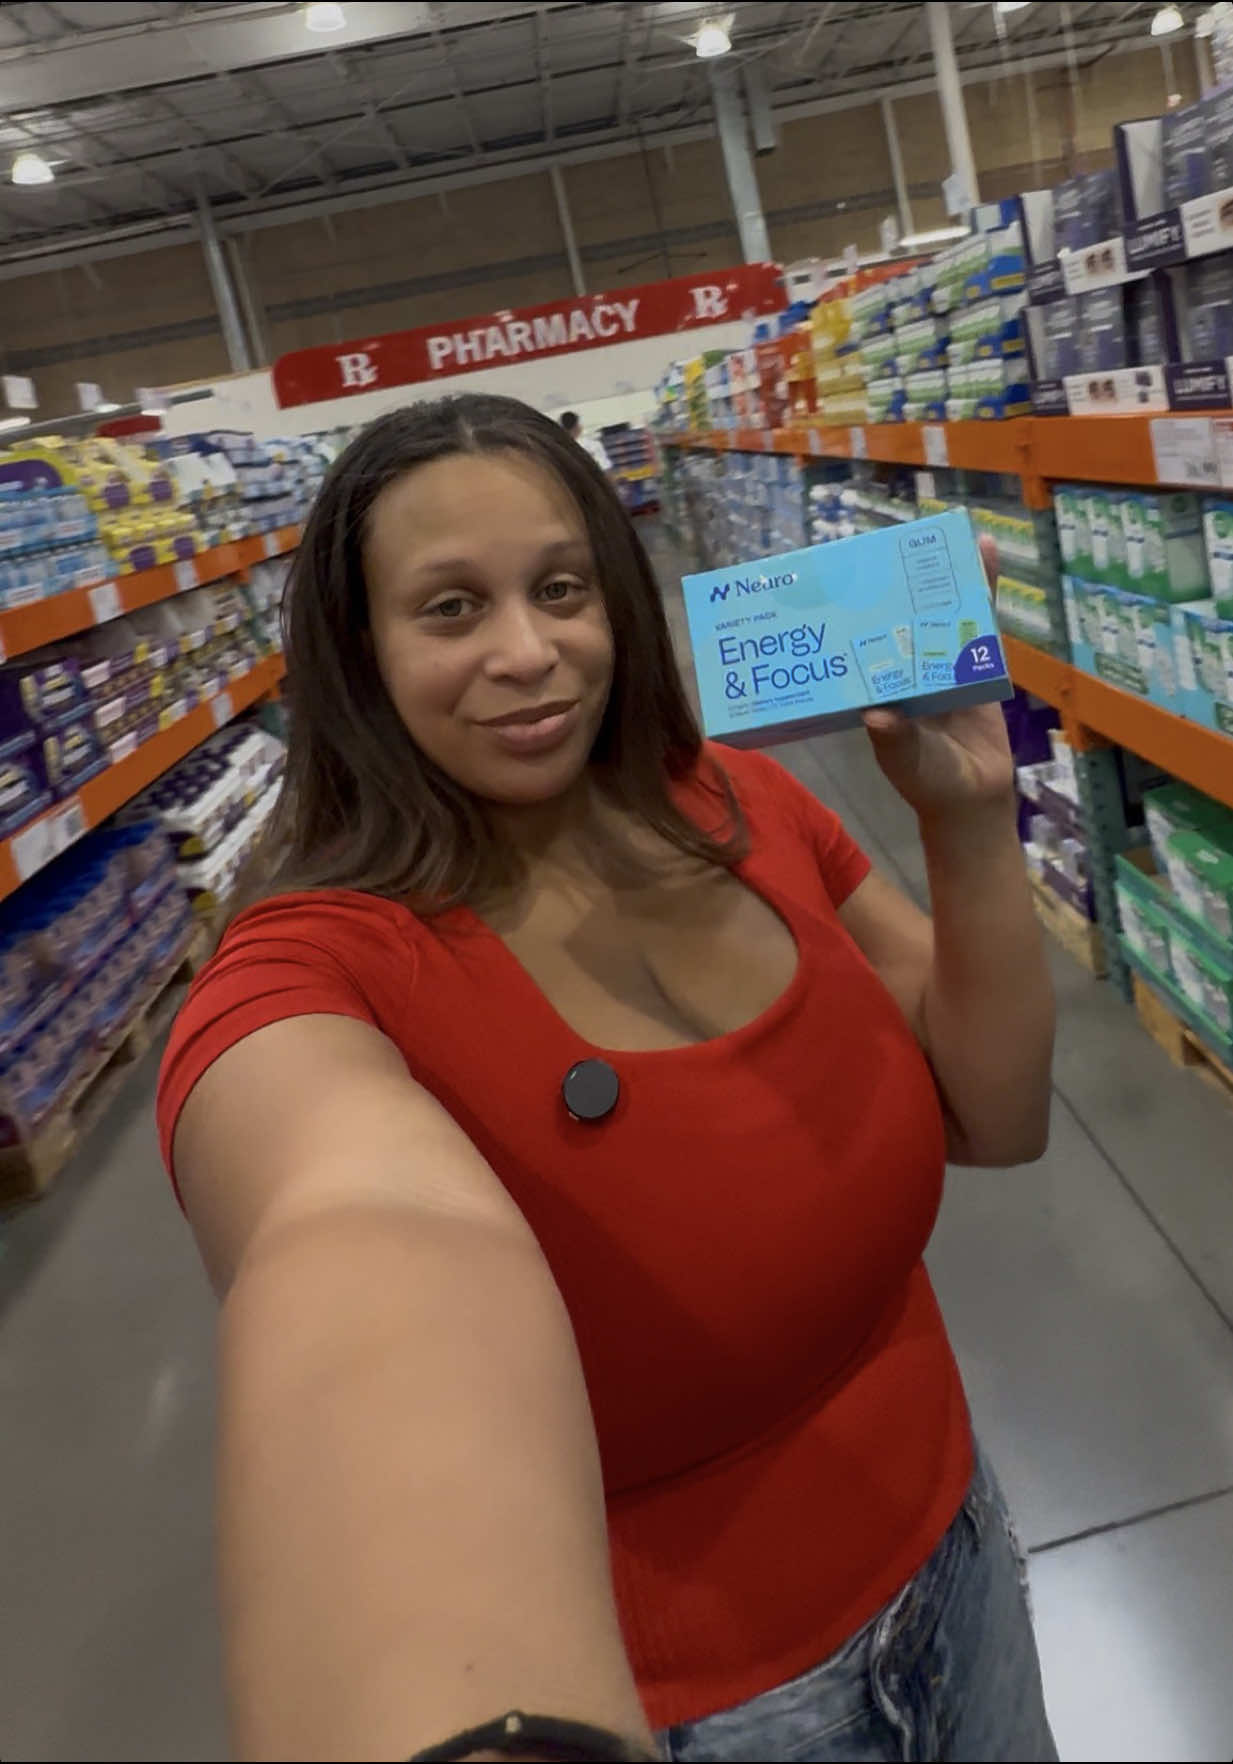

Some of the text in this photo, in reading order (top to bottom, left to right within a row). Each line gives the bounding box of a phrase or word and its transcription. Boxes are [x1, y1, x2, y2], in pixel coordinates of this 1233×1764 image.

[425, 299, 640, 370] PHARMACY
[735, 573, 794, 597] Neuro
[718, 622, 826, 666] Energy
[970, 645, 991, 663] 12
[725, 671, 747, 699] &
